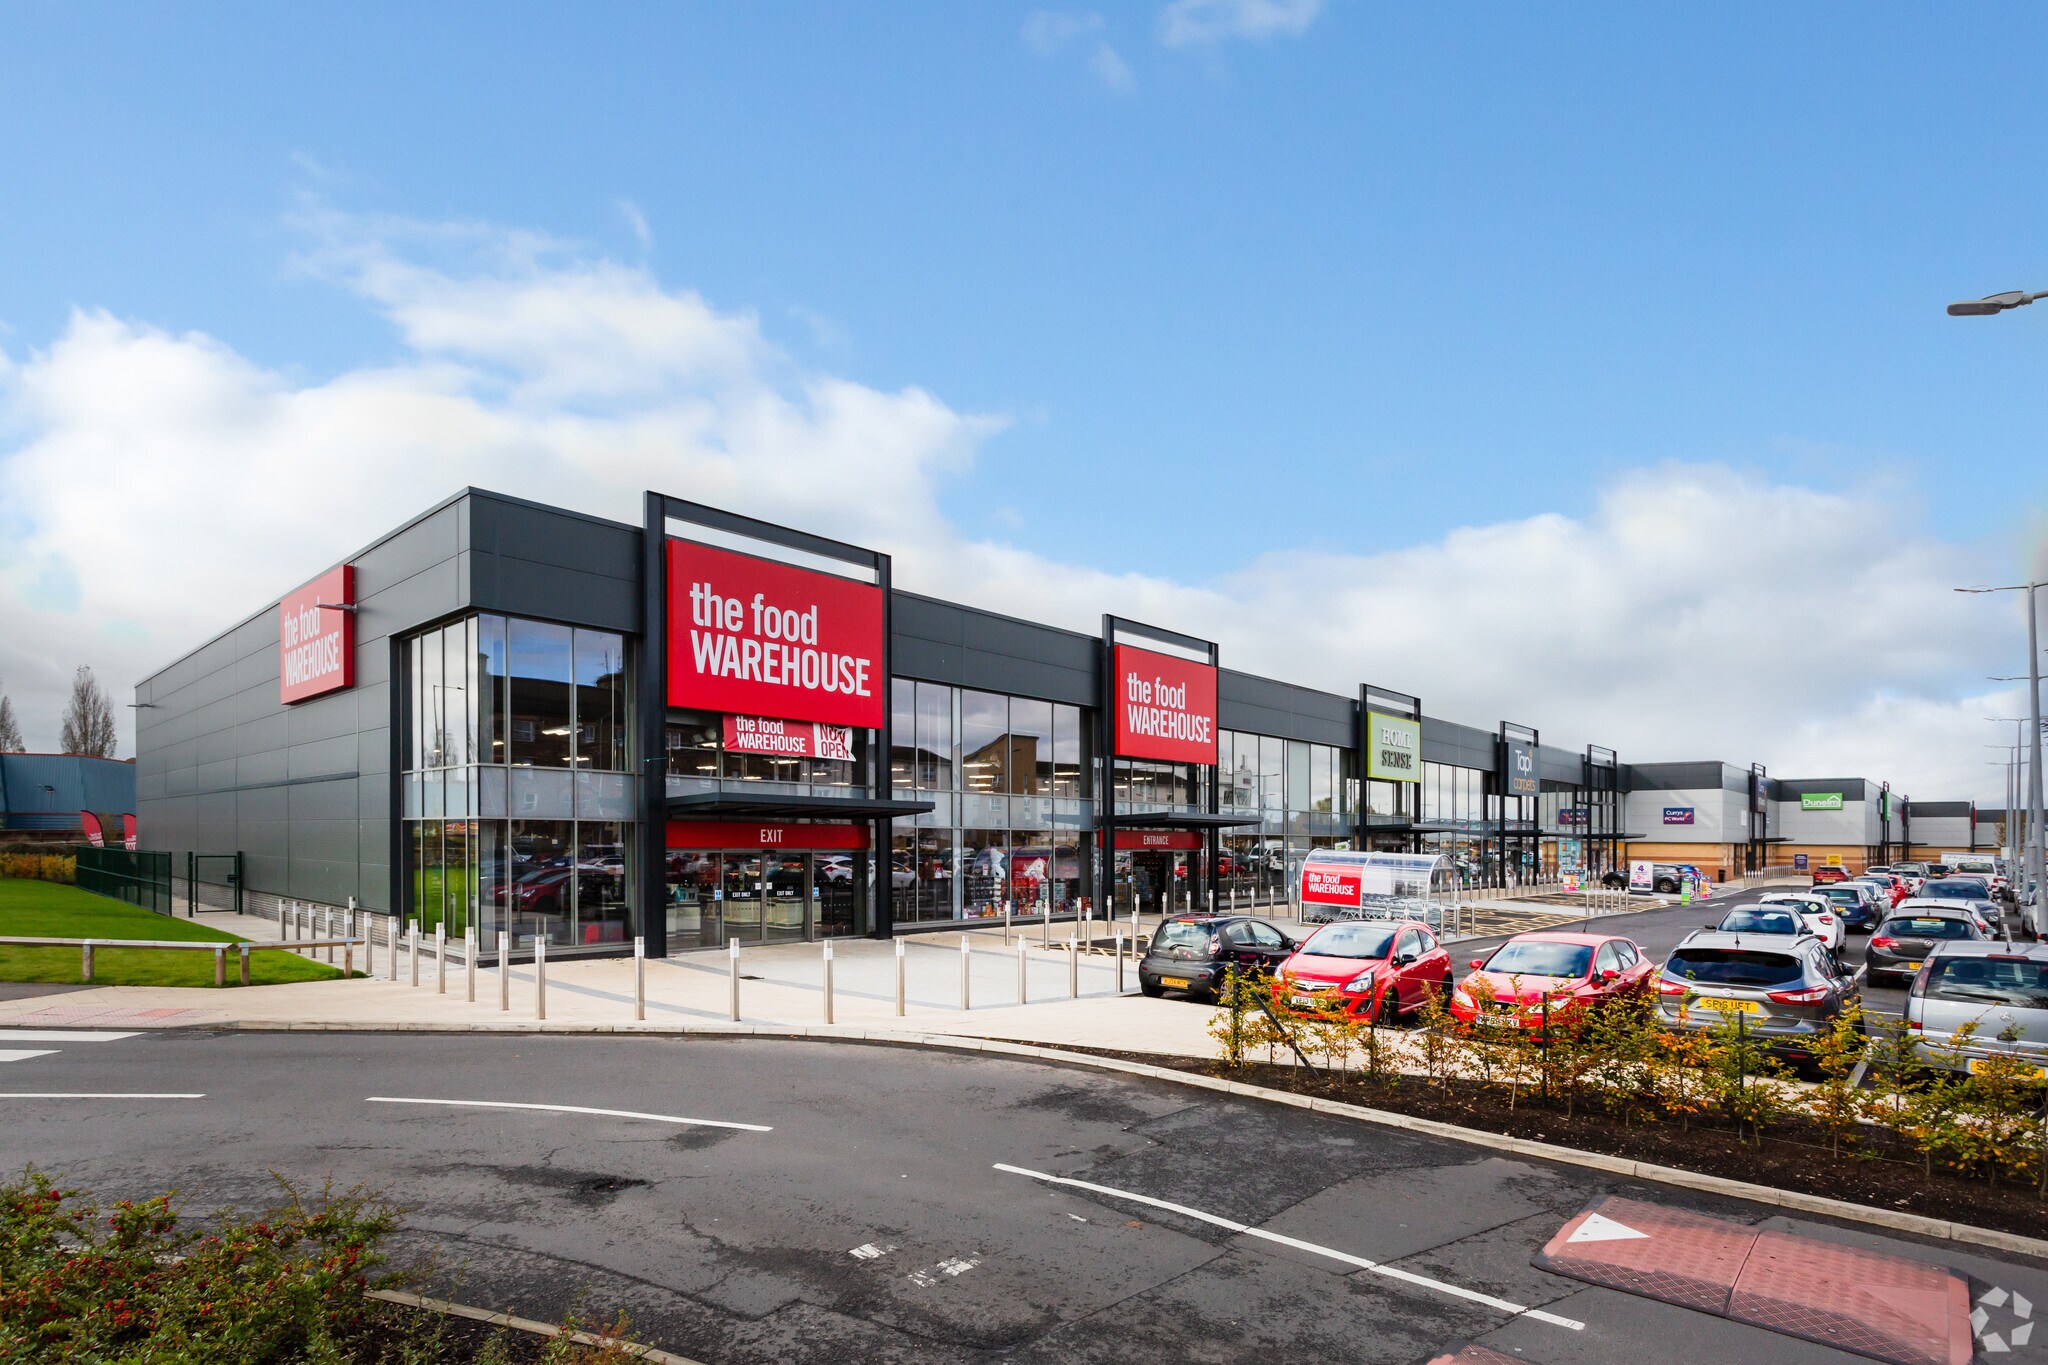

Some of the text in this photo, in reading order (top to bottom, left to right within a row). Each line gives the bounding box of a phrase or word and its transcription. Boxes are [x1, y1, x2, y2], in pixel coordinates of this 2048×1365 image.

[284, 595, 320, 648] the food
[690, 582, 817, 645] the food
[284, 631, 339, 687] WAREHOUSE
[690, 629, 871, 696] WAREHOUSE
[1127, 672, 1185, 709] the food
[736, 715, 784, 735] the food
[1127, 703, 1211, 743] WAREHOUSE
[736, 731, 807, 753] WAREHOUSE
[1381, 727, 1412, 749] HOME
[820, 740, 849, 759] OPEN
[1381, 749, 1412, 770] SENSE
[1515, 749, 1533, 776] Tapi
[1513, 777, 1536, 793] carpets
[1803, 798, 1840, 806] Dunelm
[760, 829, 783, 843] EXIT
[1143, 835, 1169, 845] ENTRANCE
[1309, 872, 1340, 884] the food
[1308, 882, 1354, 896] WAREHOUSE
